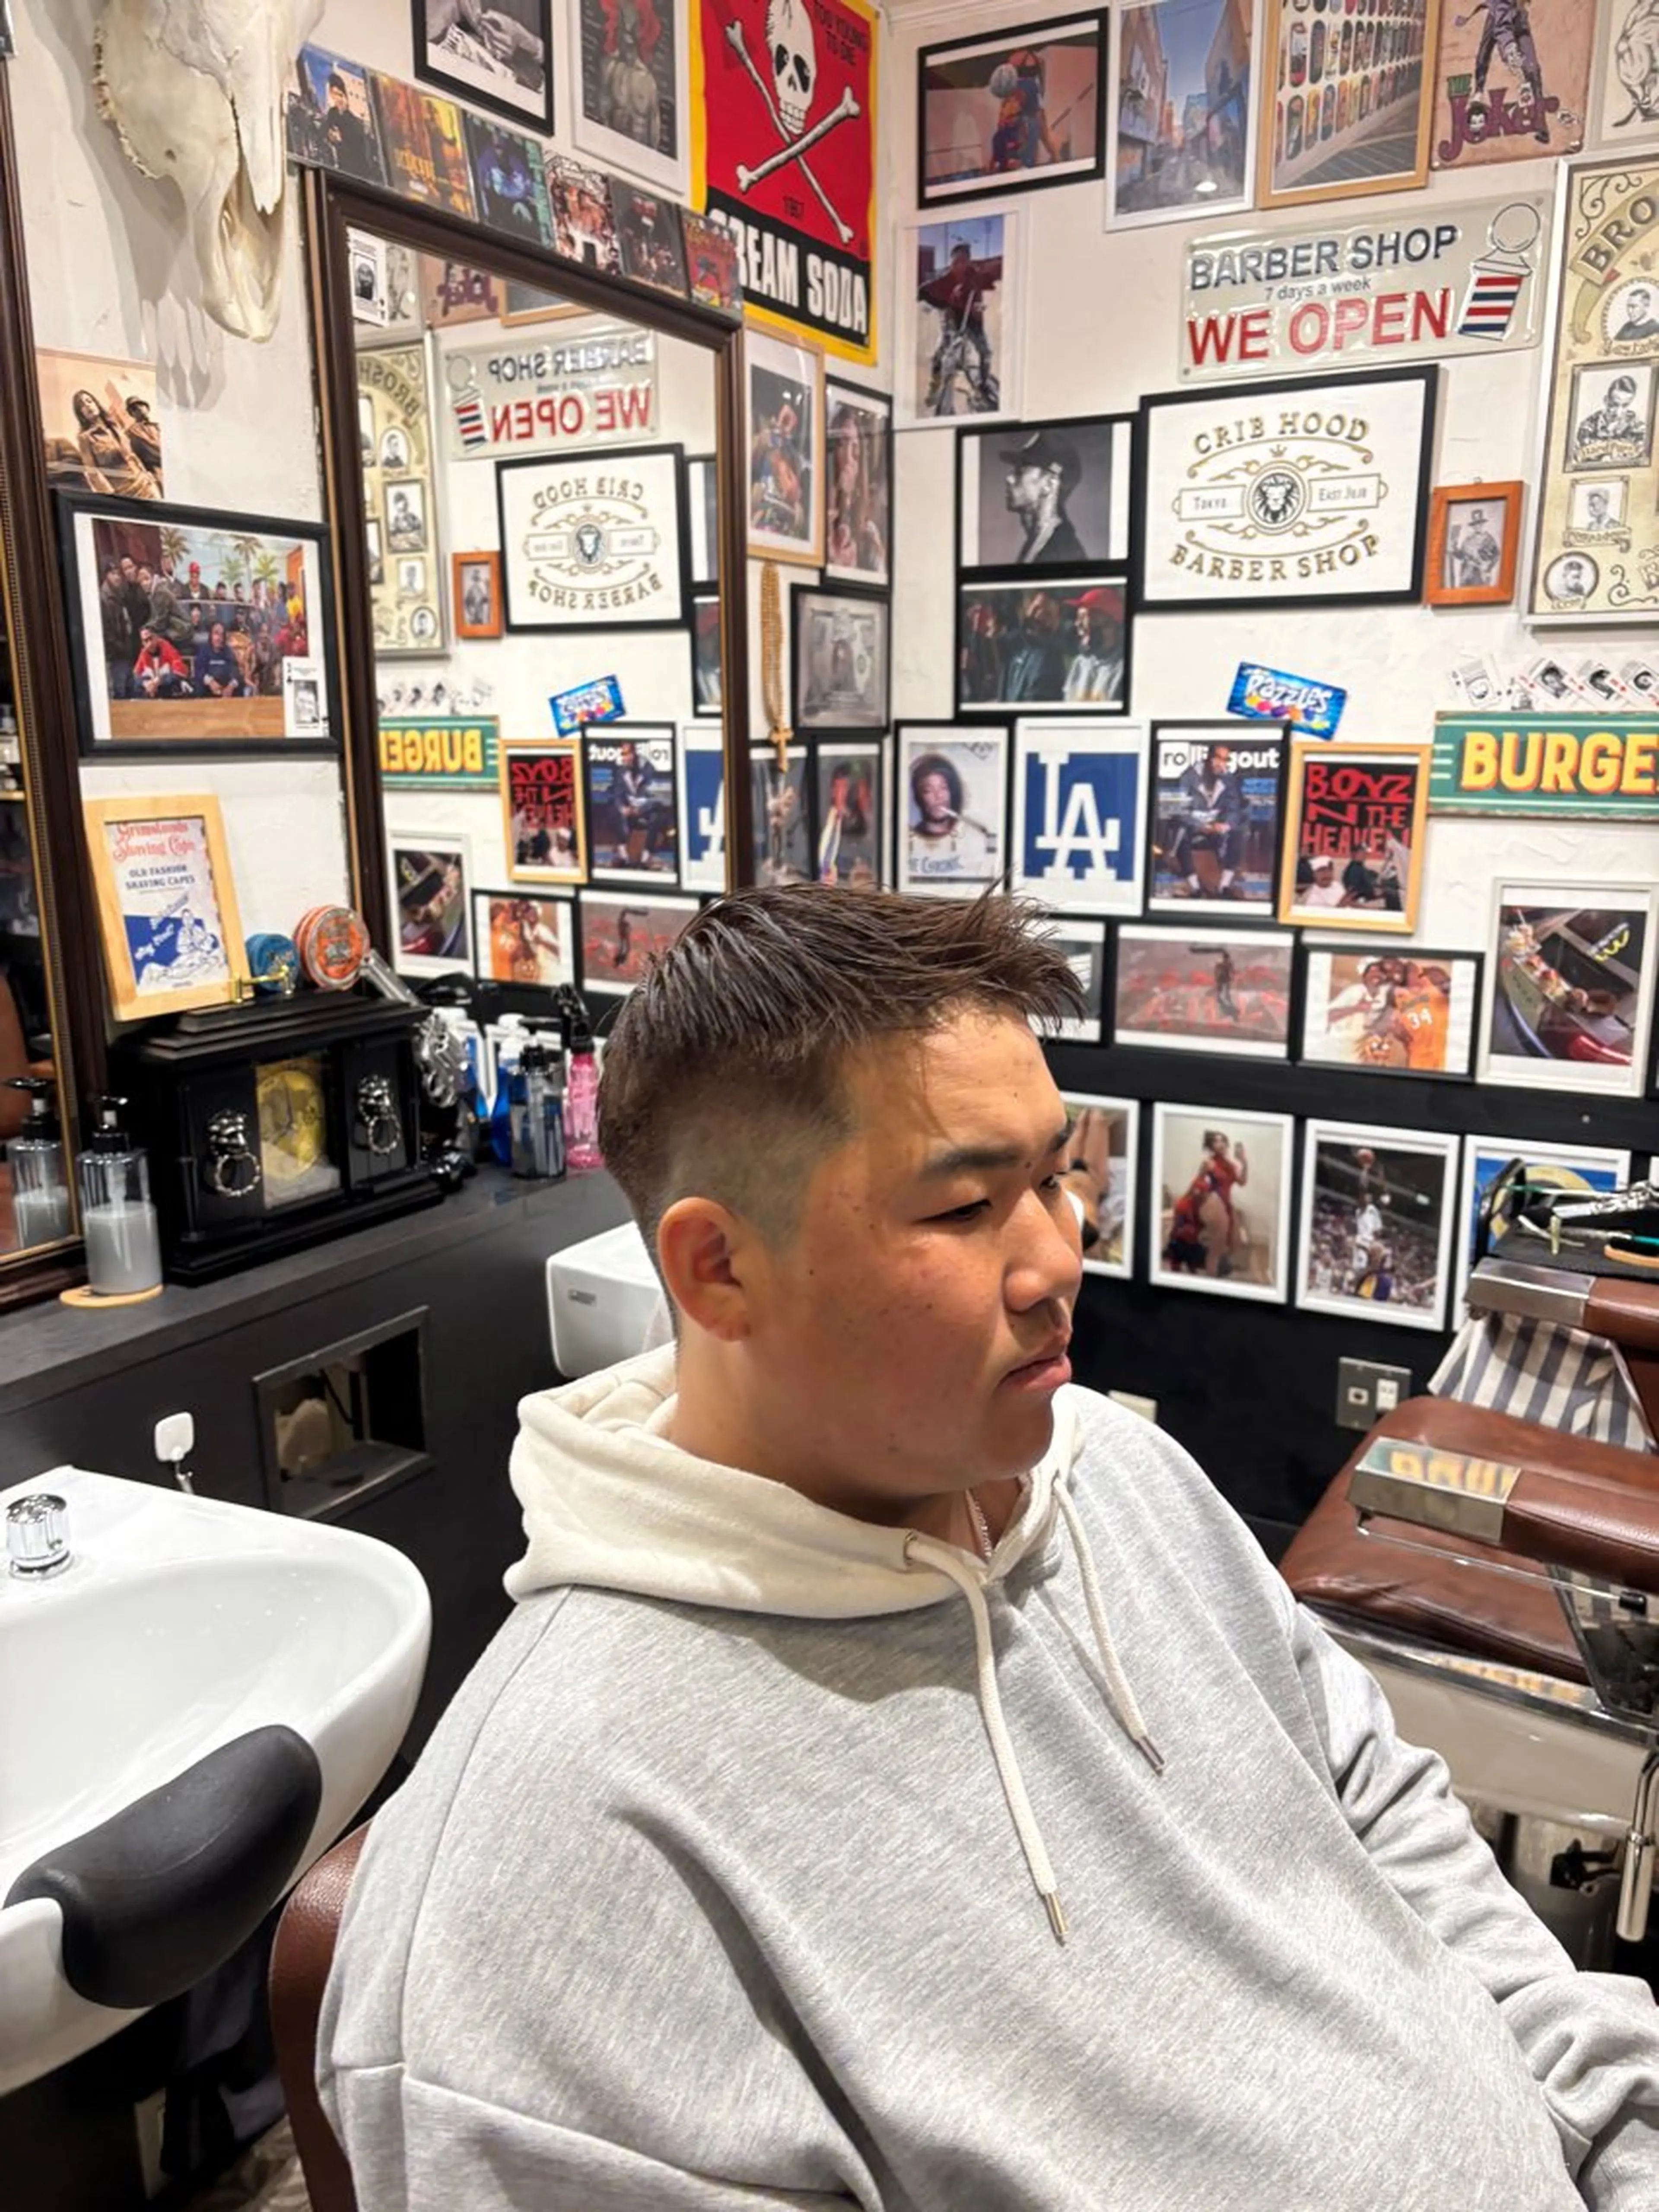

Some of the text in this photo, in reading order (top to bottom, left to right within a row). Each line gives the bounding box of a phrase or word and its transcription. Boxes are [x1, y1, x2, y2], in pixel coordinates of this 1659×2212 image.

[1191, 225, 1458, 291] BARBER SHOP
[1581, 196, 1656, 273] BRO
[709, 208, 867, 334] REAM SODA
[1265, 277, 1372, 302] 7 days a week
[1188, 288, 1450, 365] WE OPEN
[1194, 412, 1370, 454] CRIB HOOD
[1169, 534, 1379, 581] BARBER SHOP
[1164, 744, 1281, 774] rolligout
[1307, 764, 1411, 803] BOYZ
[1460, 731, 1659, 794] BURGE
[1036, 751, 1120, 880] LA
[1308, 802, 1407, 828] N THE
